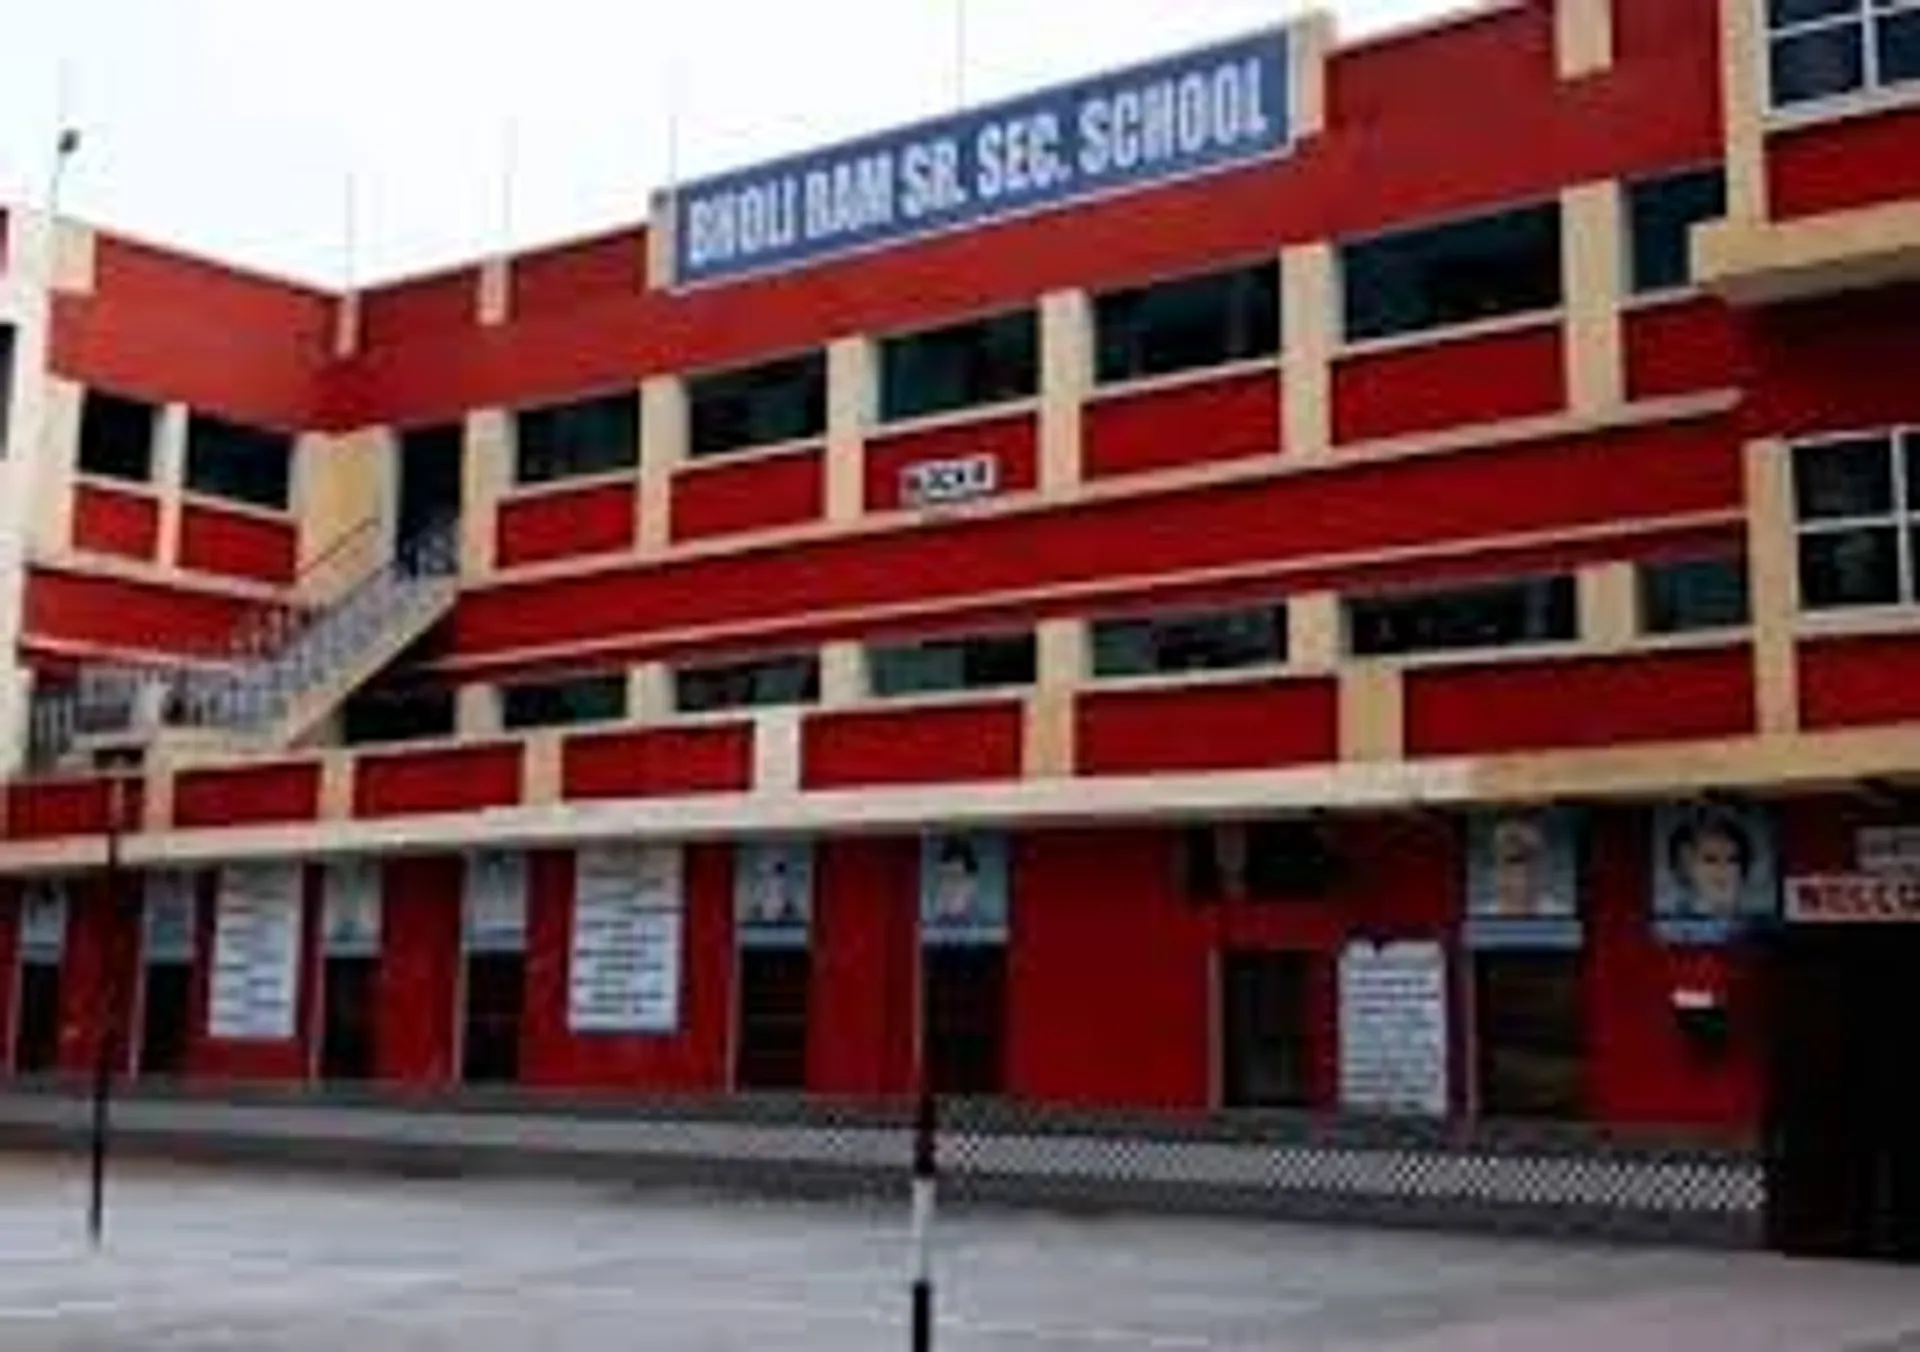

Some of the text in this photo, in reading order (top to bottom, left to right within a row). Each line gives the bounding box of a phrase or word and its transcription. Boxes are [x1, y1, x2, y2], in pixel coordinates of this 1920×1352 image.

[805, 151, 895, 239] RAM
[903, 136, 967, 218] SR.
[976, 114, 1072, 200] SEC.
[1078, 57, 1268, 175] SCHOOL
